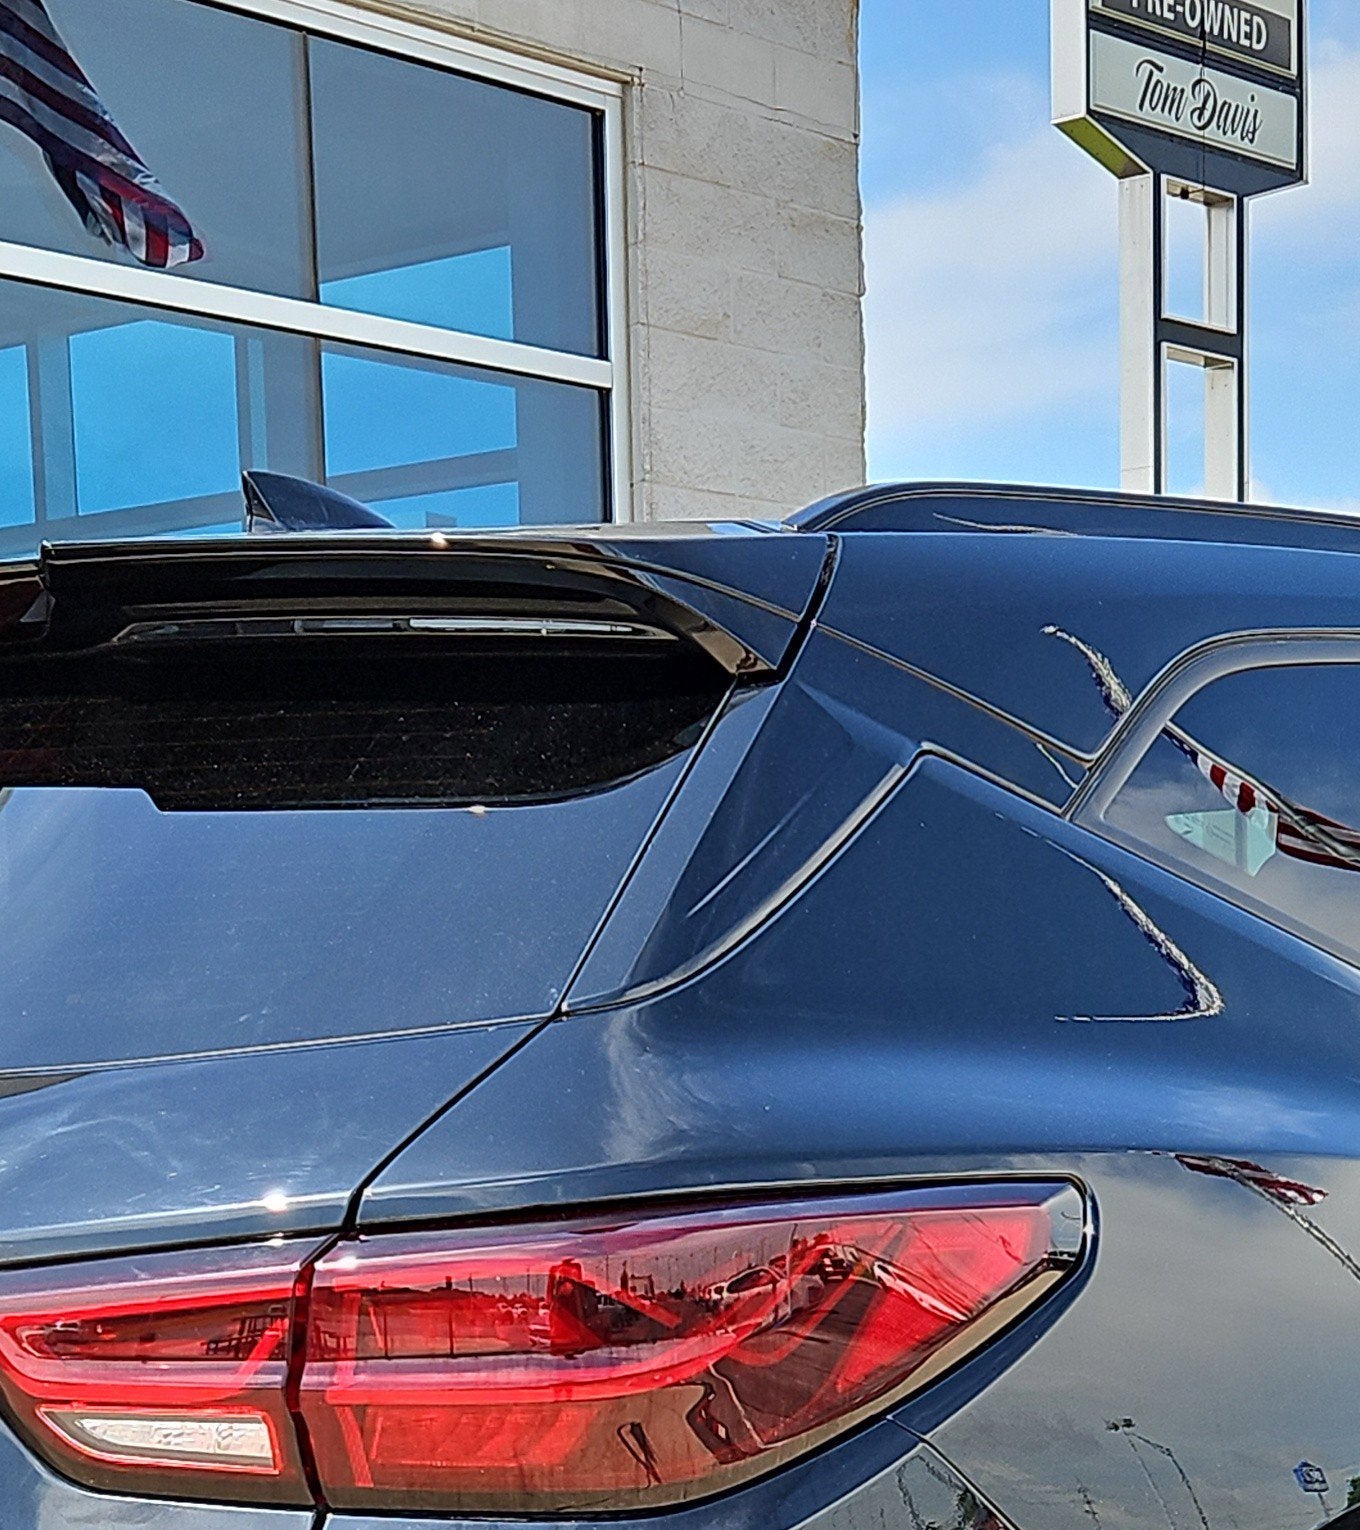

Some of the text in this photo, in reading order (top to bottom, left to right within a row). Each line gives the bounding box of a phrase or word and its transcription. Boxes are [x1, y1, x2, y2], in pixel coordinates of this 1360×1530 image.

[1131, 0, 1268, 50] E-OWNED
[1136, 59, 1263, 145] Tom Davis
